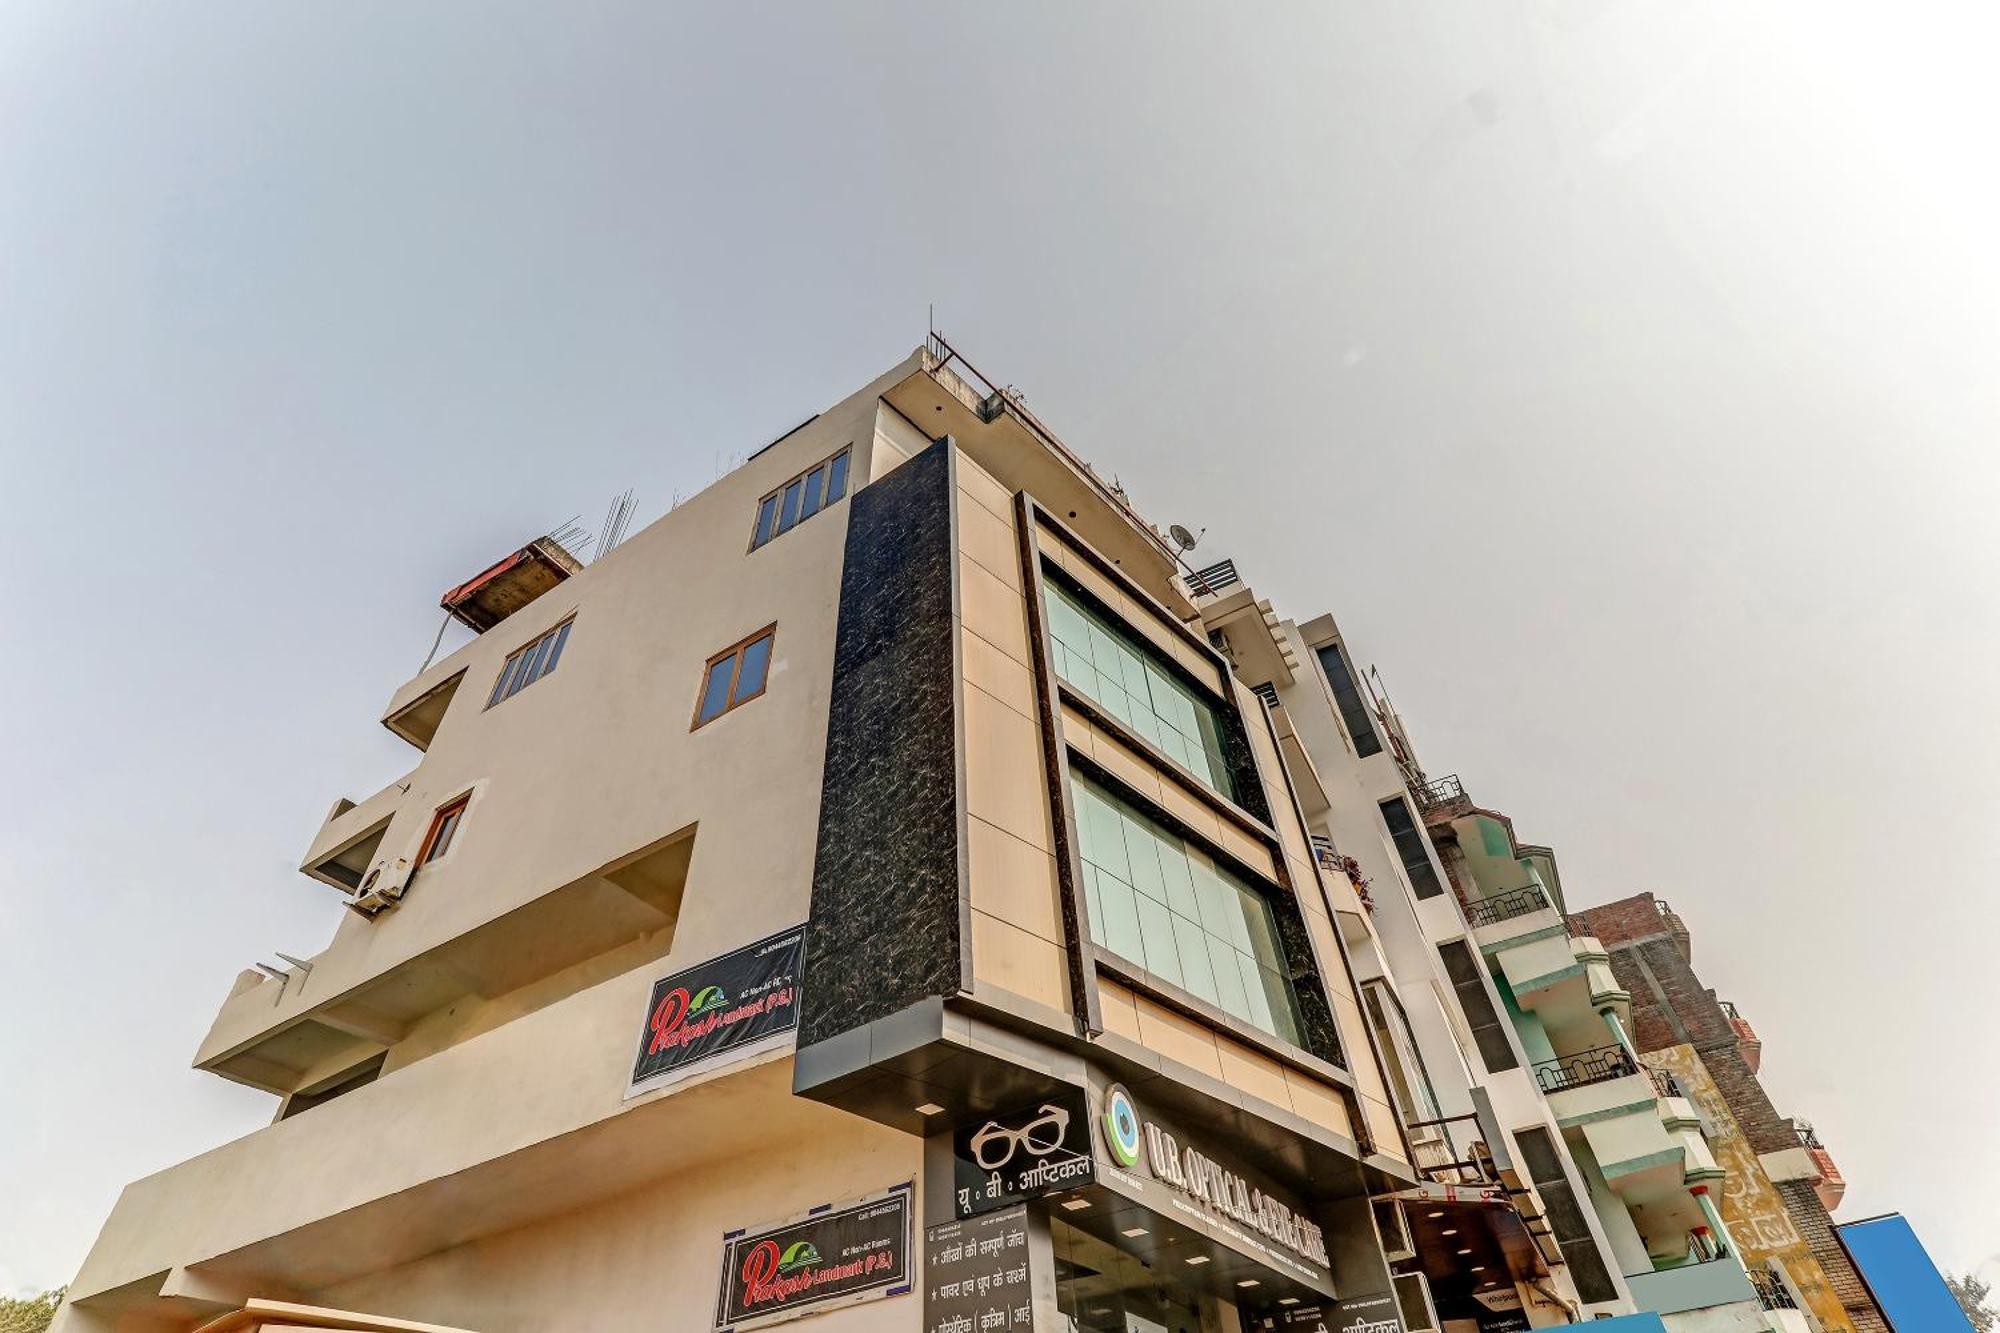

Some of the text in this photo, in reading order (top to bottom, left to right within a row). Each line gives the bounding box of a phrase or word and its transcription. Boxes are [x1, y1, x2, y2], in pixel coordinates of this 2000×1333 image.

[1182, 1146, 1260, 1230] OPTICAL
[965, 1238, 977, 1258] की
[742, 1240, 812, 1307] Prakash
[813, 1260, 863, 1286] Landmark
[940, 1282, 960, 1298] पावर
[993, 1267, 1003, 1287] के
